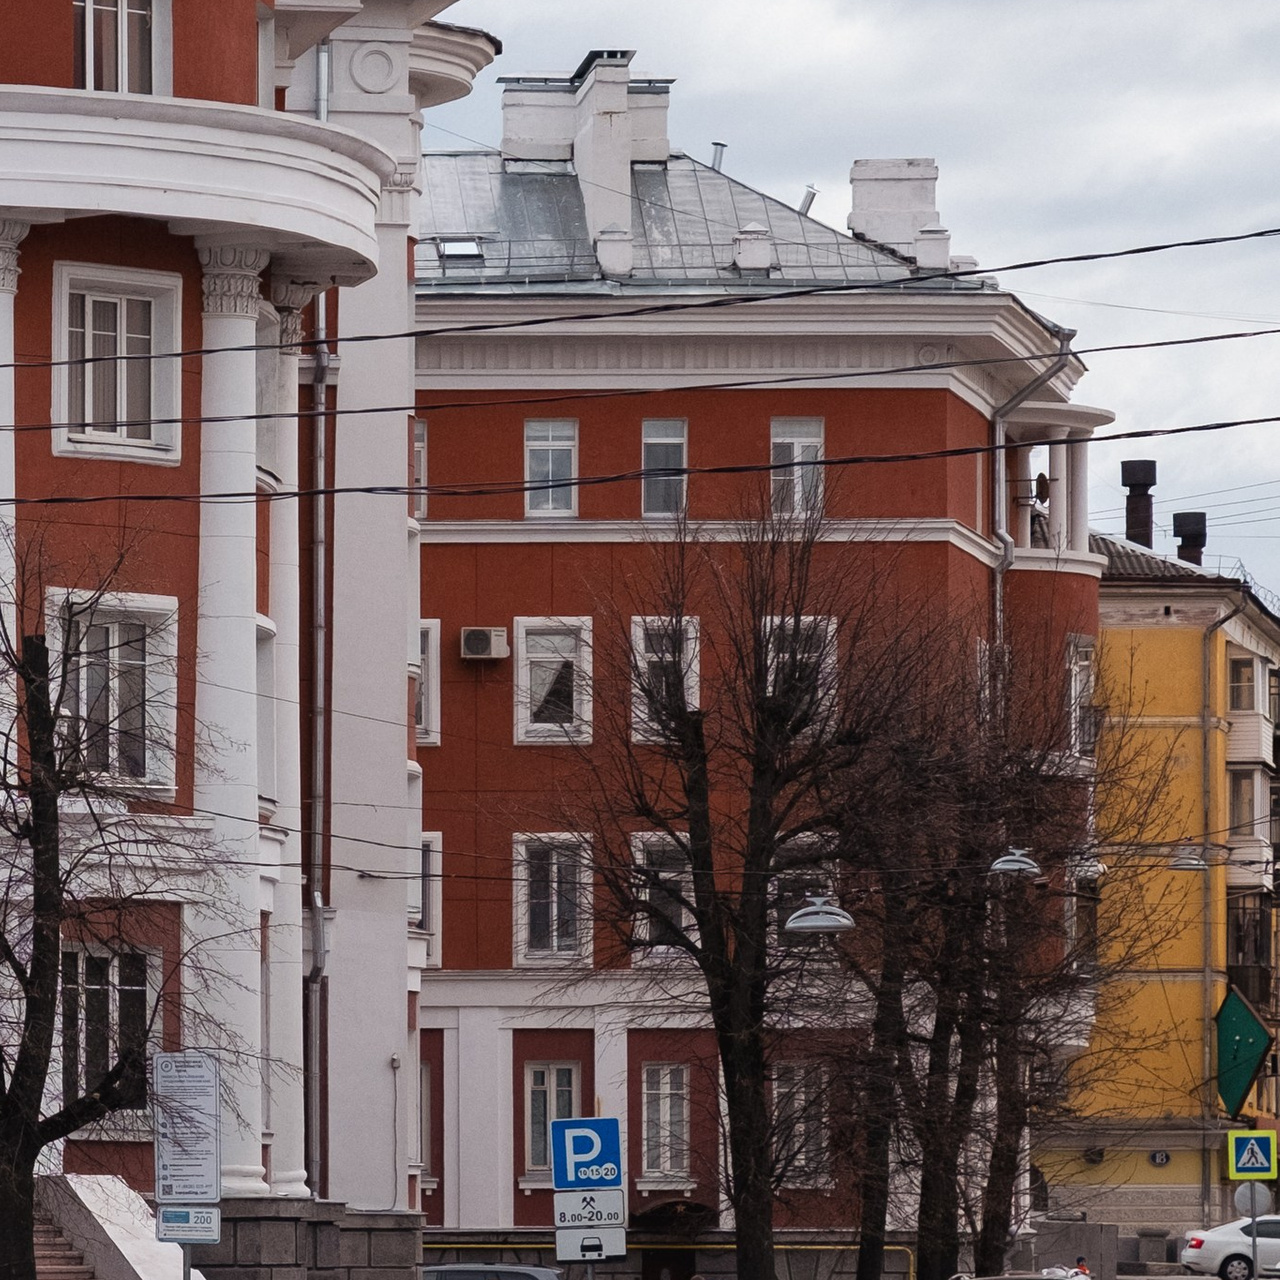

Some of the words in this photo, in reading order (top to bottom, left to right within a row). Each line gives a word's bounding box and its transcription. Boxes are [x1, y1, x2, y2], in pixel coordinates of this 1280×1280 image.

[565, 1128, 602, 1181] P
[1156, 1153, 1166, 1163] 18
[590, 1168, 601, 1176] 15
[603, 1167, 616, 1177] 20
[193, 1215, 212, 1225] 200
[559, 1210, 619, 1223] 8.00-20.00
